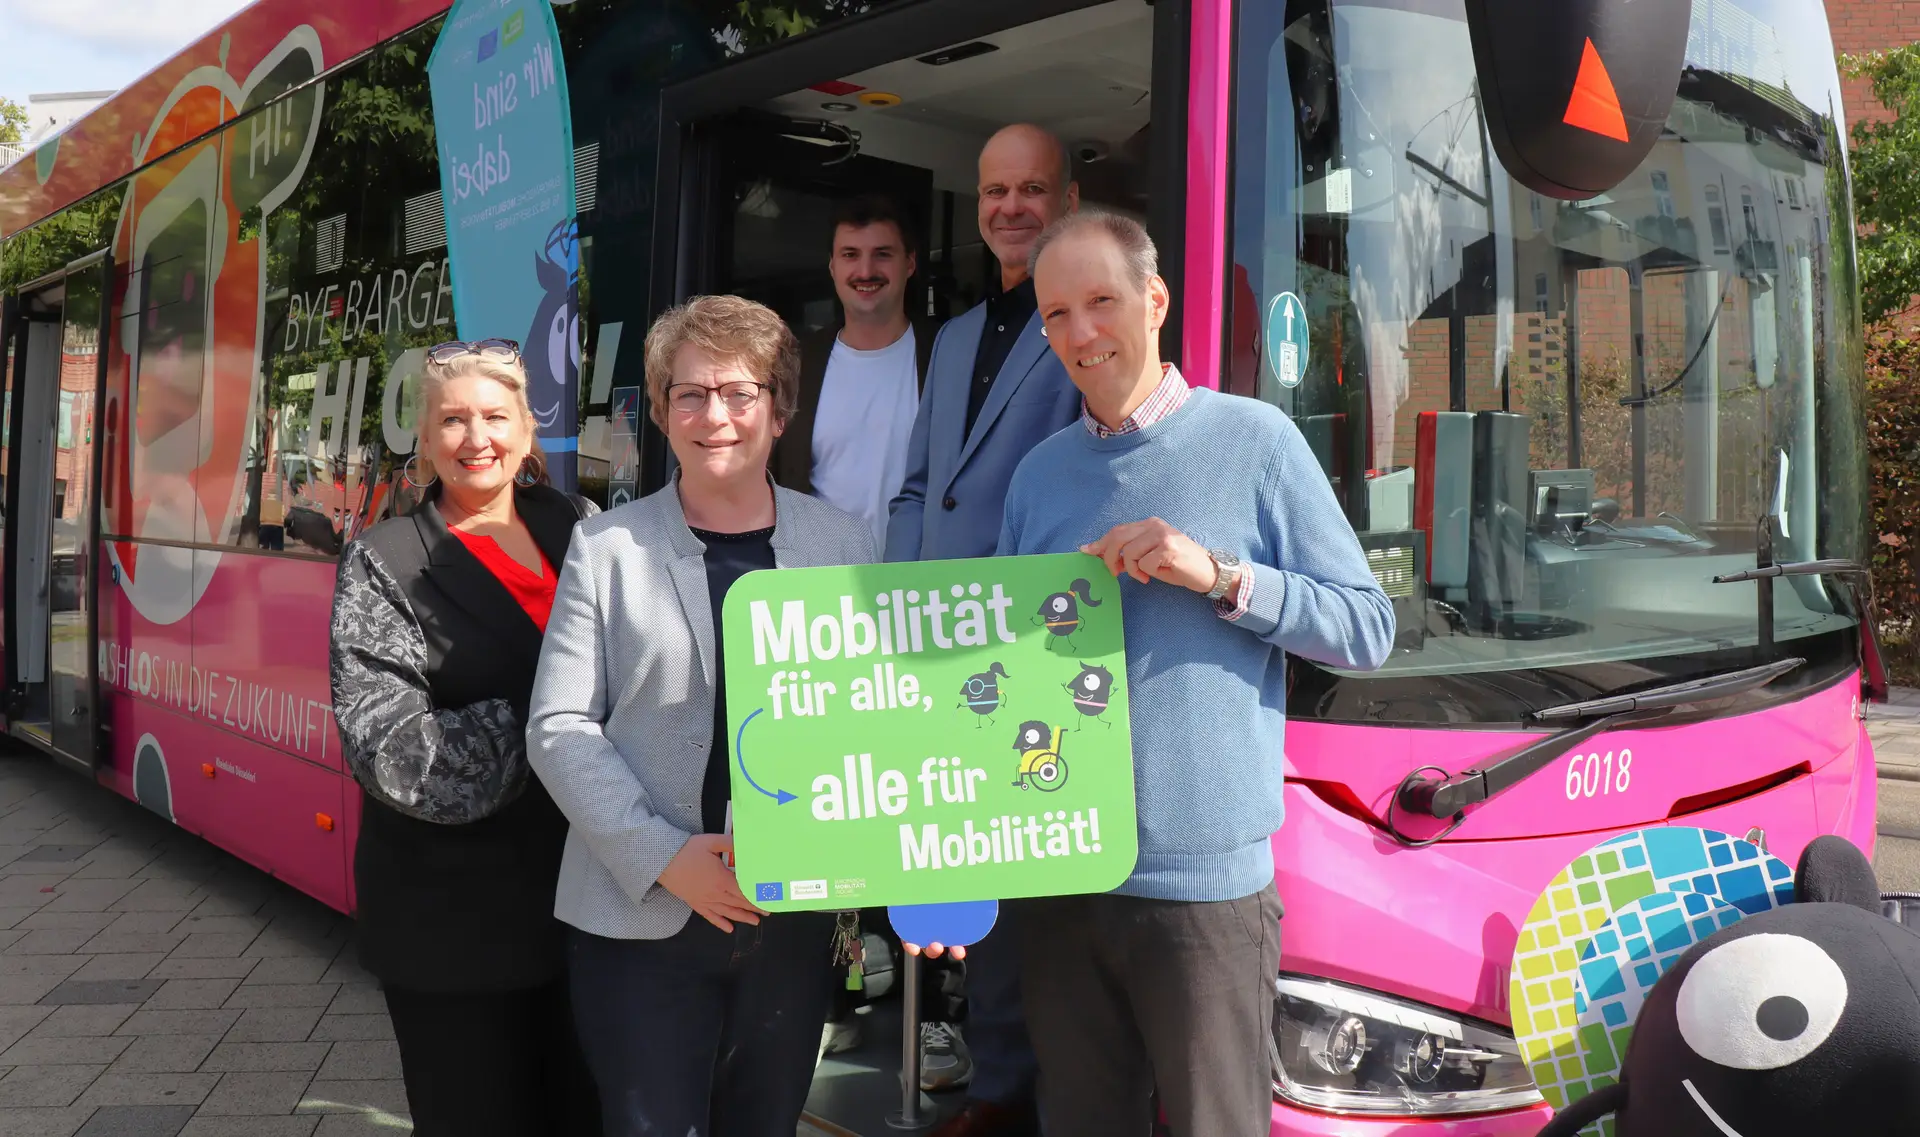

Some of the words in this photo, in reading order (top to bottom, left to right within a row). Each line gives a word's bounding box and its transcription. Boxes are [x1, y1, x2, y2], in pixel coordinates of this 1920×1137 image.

[284, 284, 338, 352] BYE
[342, 256, 456, 341] BARGE
[308, 356, 370, 455] HI
[749, 582, 1016, 666] Mobilität
[98, 640, 160, 700] ASHLOS
[165, 659, 183, 708] IN
[188, 666, 219, 722] DIE
[223, 676, 333, 759] ZUKUNFT
[767, 669, 837, 720] für
[850, 662, 934, 713] alle,
[810, 753, 909, 822] alle
[917, 756, 988, 808] für
[1566, 748, 1632, 800] 6018
[899, 807, 1102, 871] Mobilität!
